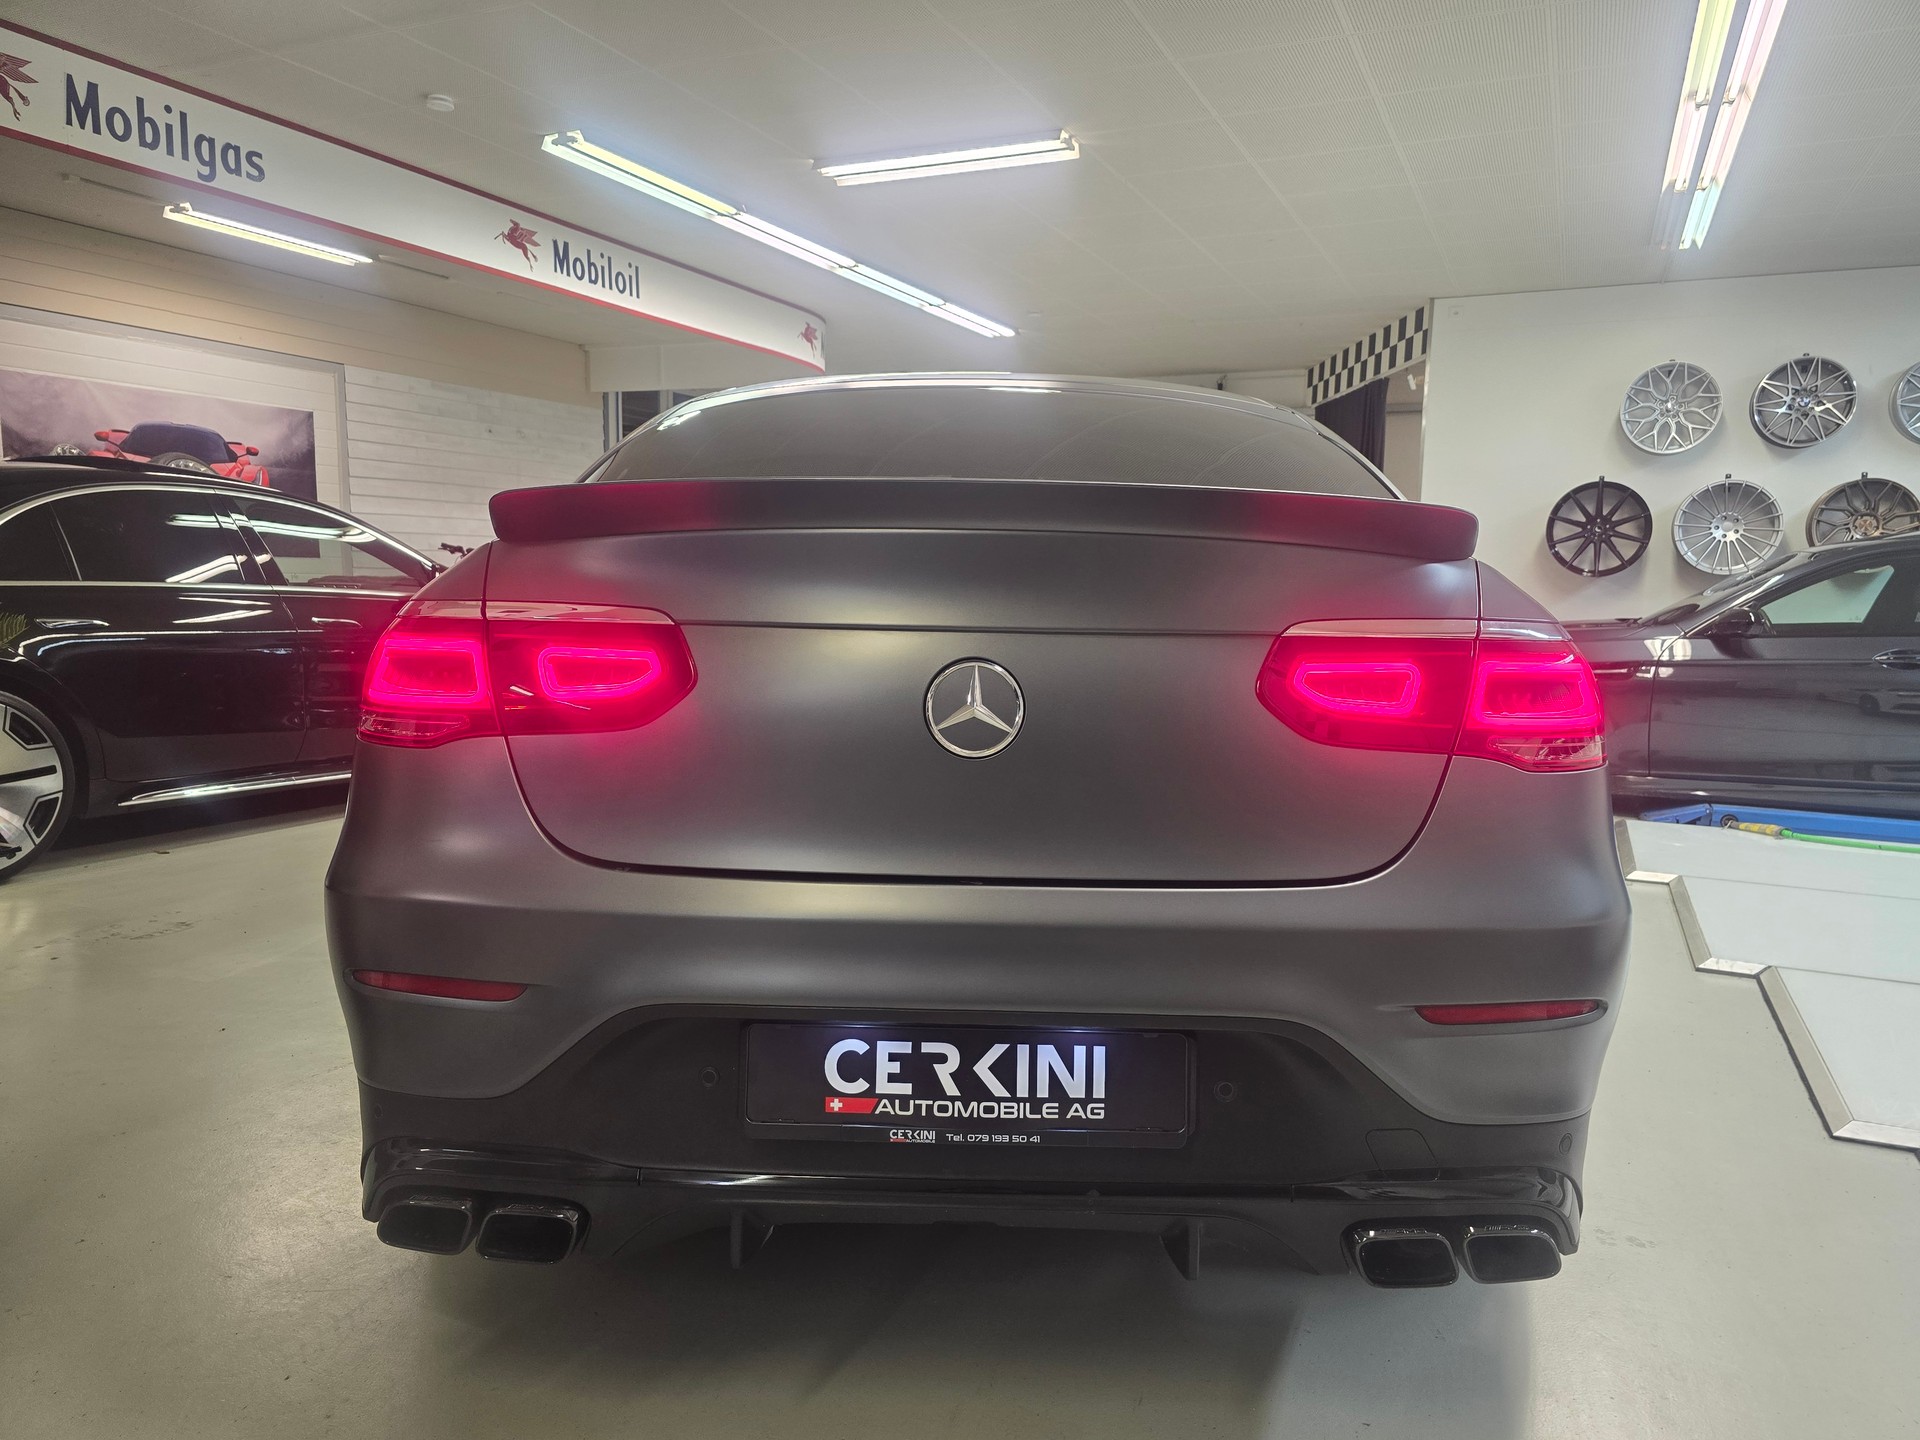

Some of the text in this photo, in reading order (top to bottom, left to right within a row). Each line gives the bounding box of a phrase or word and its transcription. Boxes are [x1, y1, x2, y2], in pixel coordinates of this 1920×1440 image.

[66, 73, 266, 183] Mobilgas
[552, 239, 640, 299] Mobiloil
[824, 1038, 1106, 1099] CERKINI
[874, 1098, 1105, 1119] AUTOMOBILE AG
[889, 1129, 936, 1140] CERKINI
[945, 1133, 1041, 1143] Tel. 079 193 50 41
